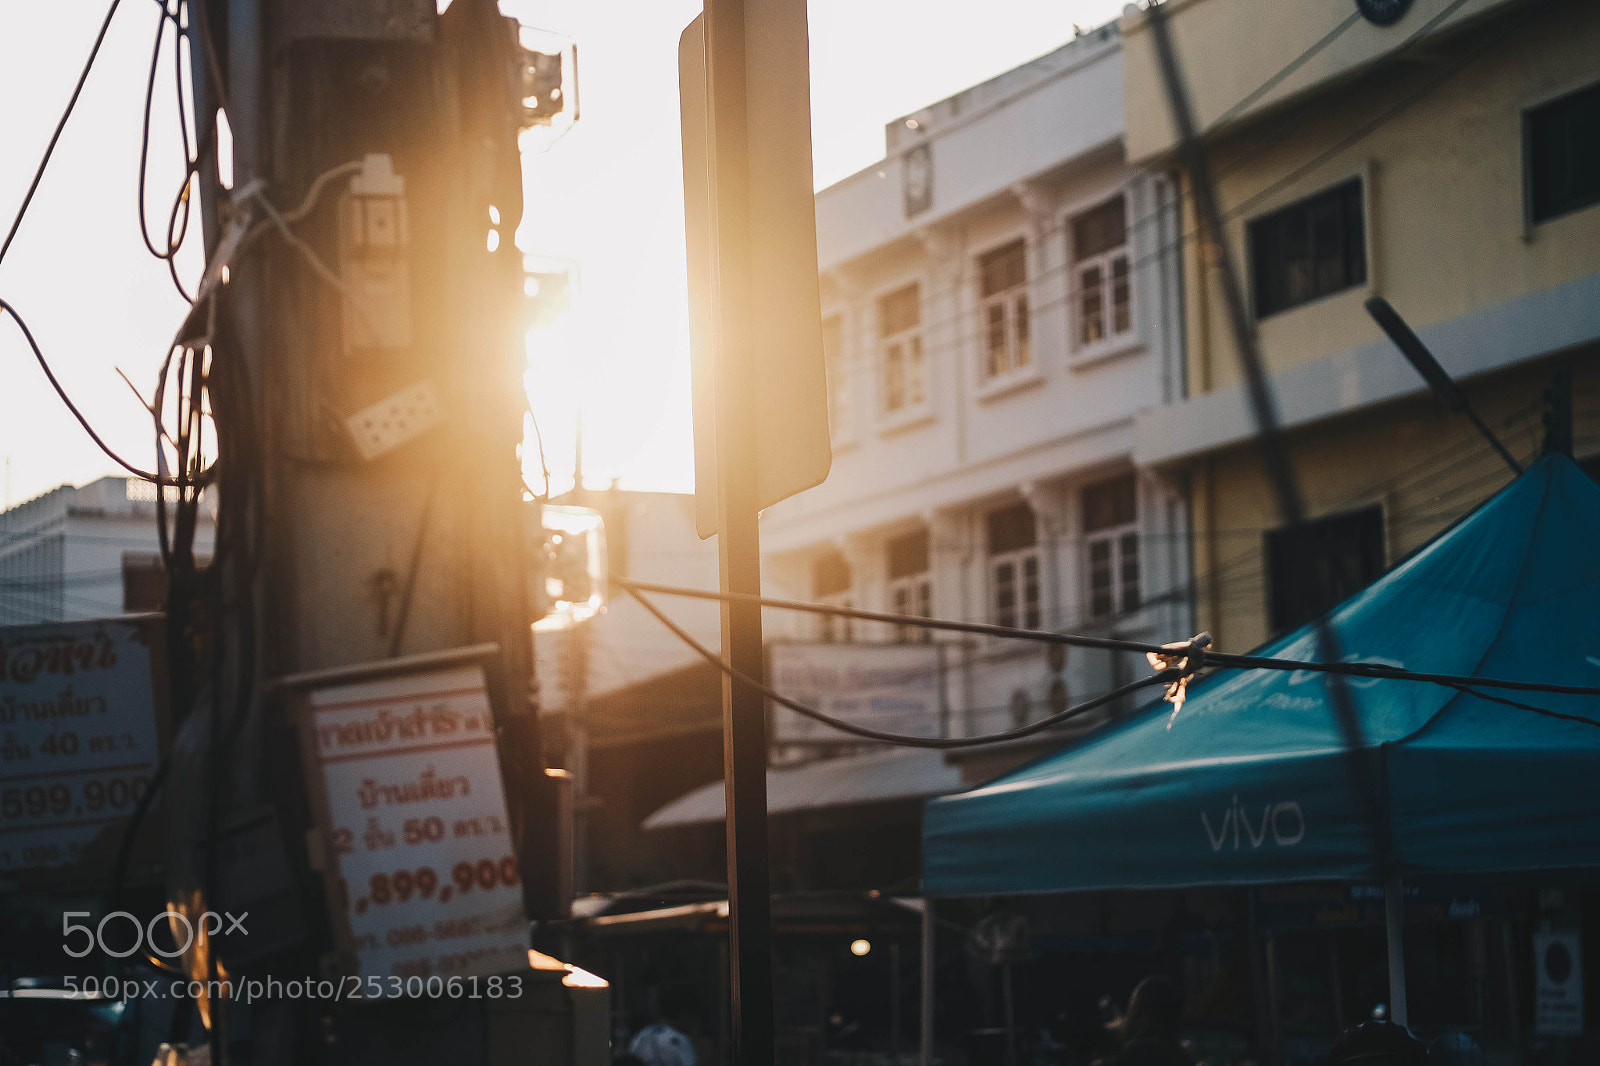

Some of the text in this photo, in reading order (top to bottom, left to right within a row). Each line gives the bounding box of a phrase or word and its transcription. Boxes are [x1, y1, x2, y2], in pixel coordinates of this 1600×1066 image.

[40, 731, 79, 756] 40
[332, 826, 354, 854] 2
[403, 815, 445, 846] 50
[1201, 795, 1306, 851] vivo
